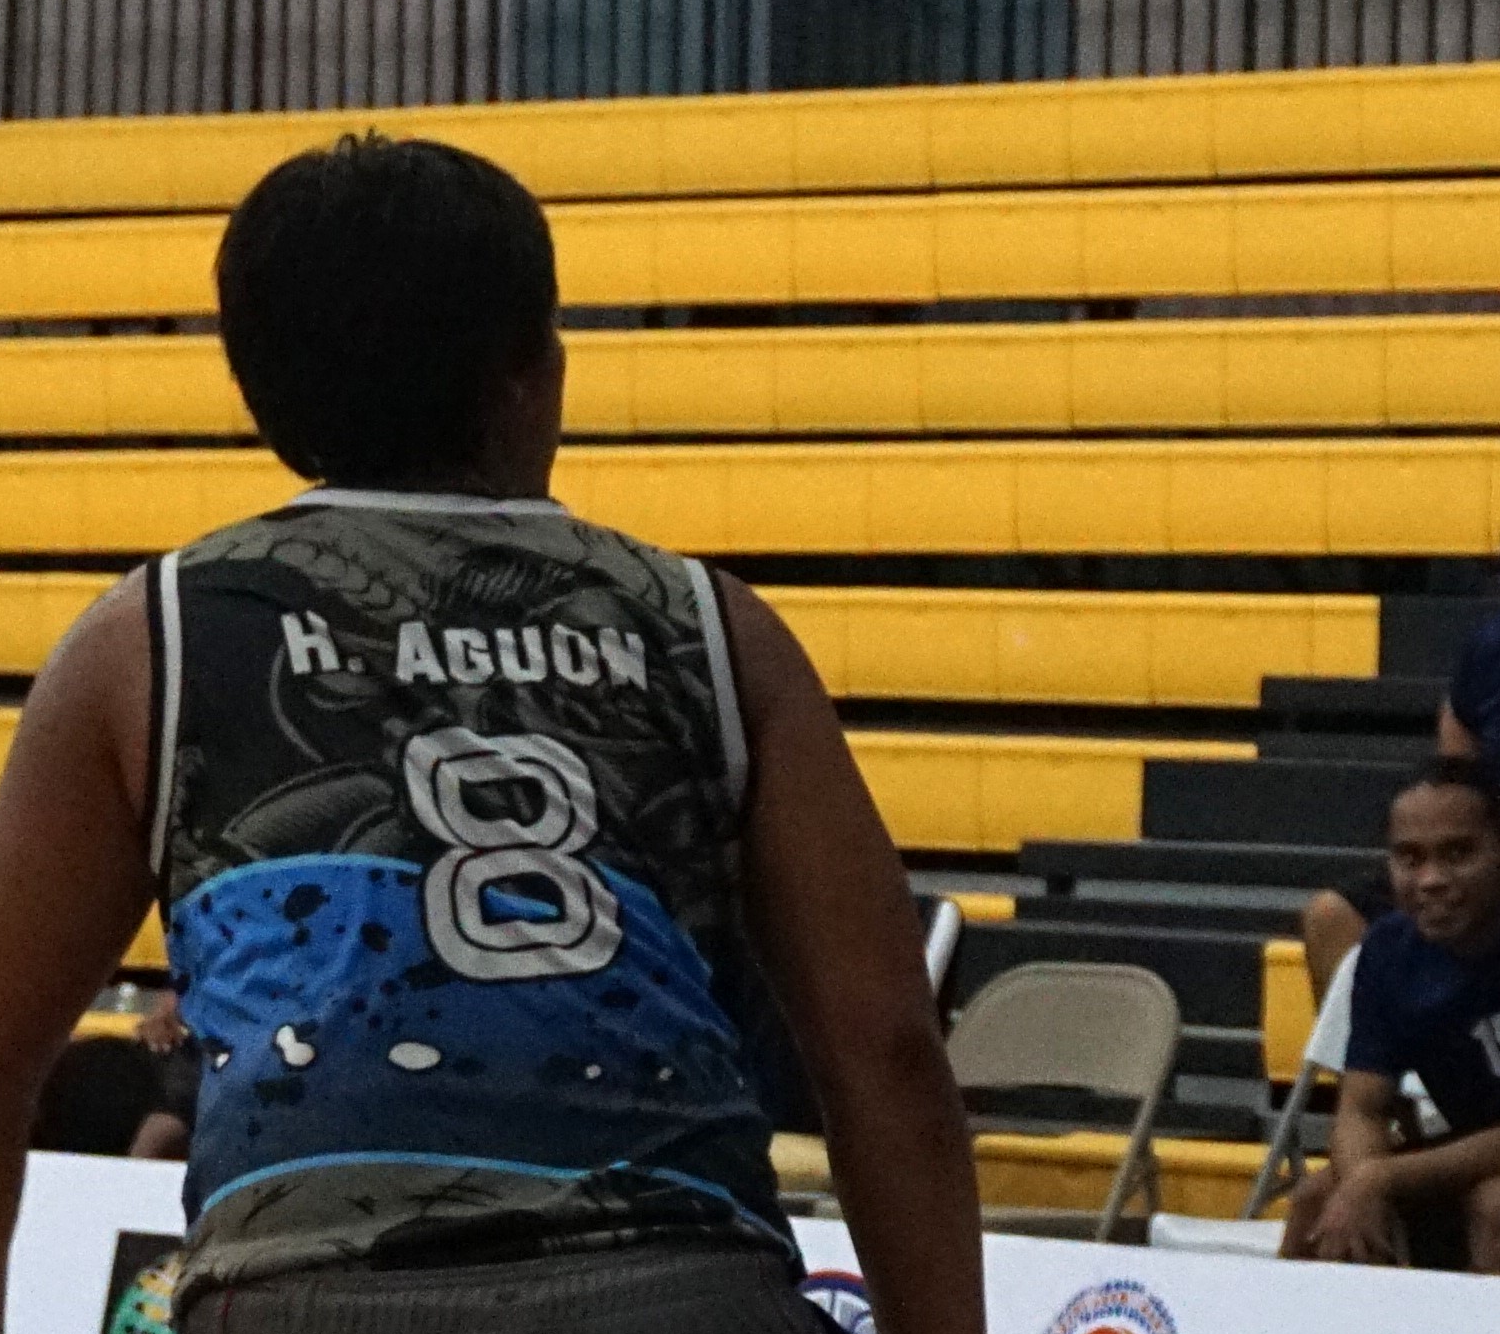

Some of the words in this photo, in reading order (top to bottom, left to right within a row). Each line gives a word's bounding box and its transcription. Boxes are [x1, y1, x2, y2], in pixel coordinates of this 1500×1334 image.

[280, 610, 364, 674] H.
[394, 620, 648, 692] AGUON
[403, 725, 625, 982] 8
